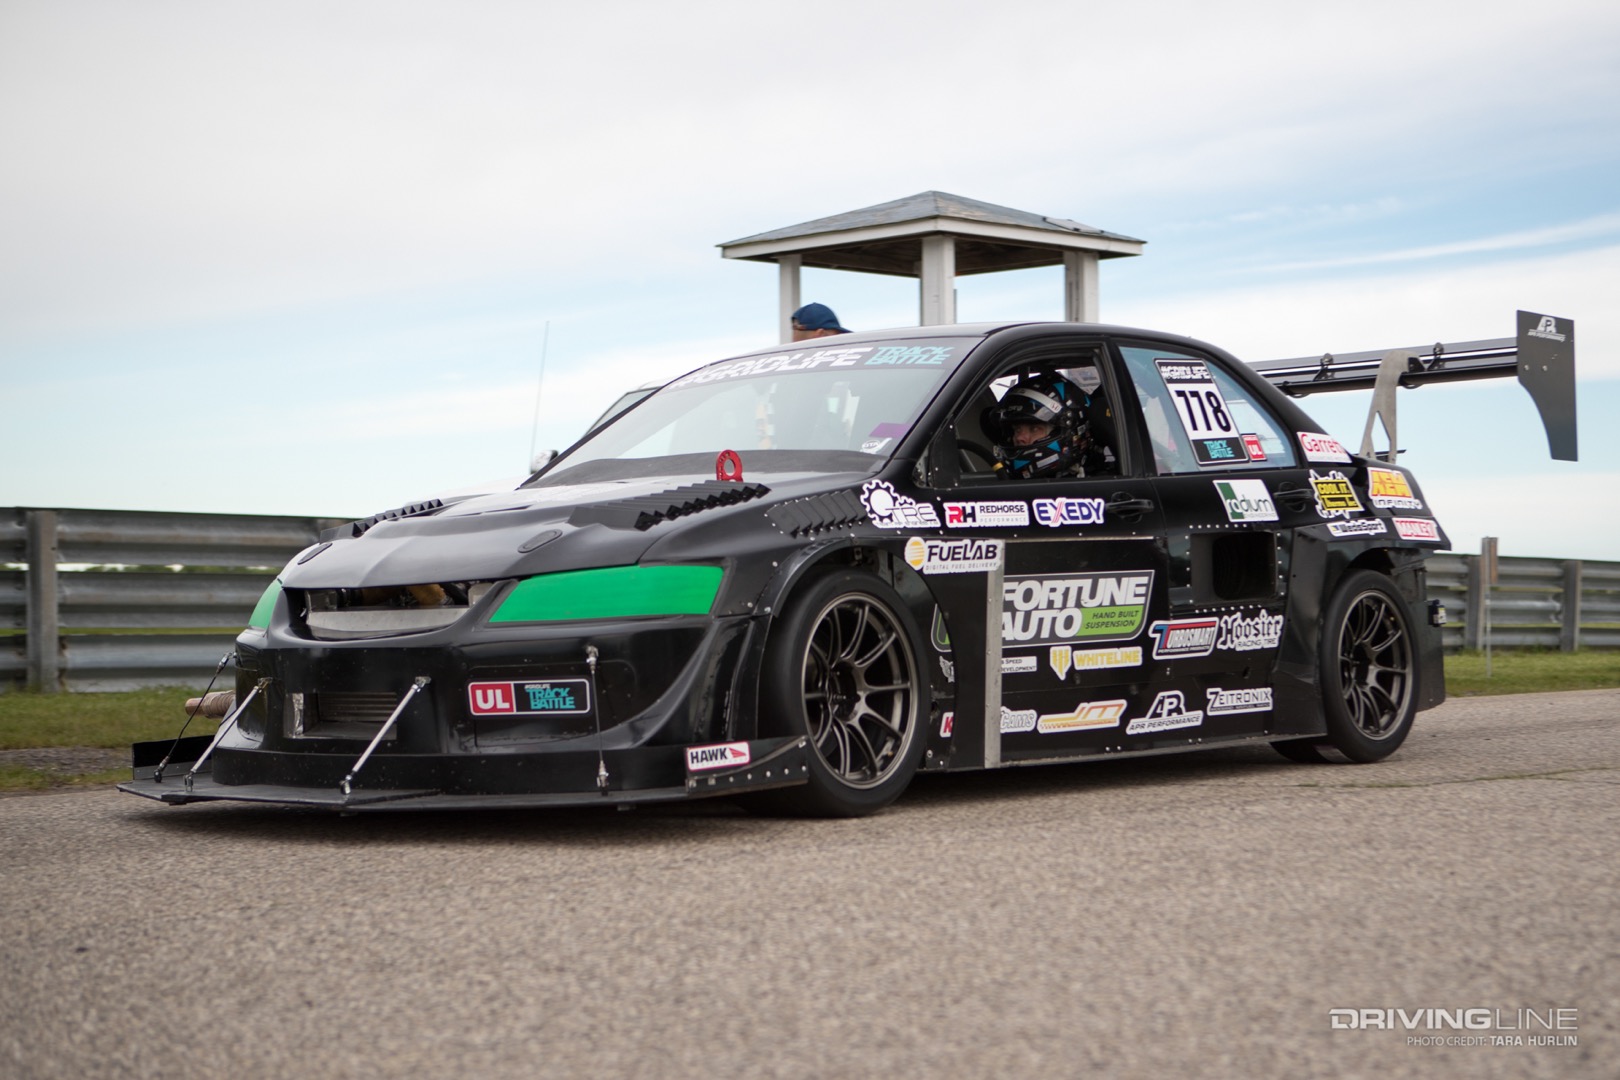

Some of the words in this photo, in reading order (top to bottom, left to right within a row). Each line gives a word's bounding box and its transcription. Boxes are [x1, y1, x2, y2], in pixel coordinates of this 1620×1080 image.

[878, 346, 955, 357] TRACK
[864, 354, 950, 365] BATTLE
[1174, 390, 1231, 432] 778
[1203, 440, 1229, 450] TRACK
[1248, 444, 1262, 455] UL
[1210, 447, 1235, 459] BATTLE
[1316, 483, 1341, 495] COOL
[980, 505, 1025, 514] REDHORSE
[1036, 501, 1101, 524] EXEDY
[980, 515, 1027, 523] PERFORMANCE
[968, 561, 997, 569] DELIVERY
[1092, 611, 1116, 620] HAND
[1117, 610, 1140, 618] BUILT
[1085, 620, 1135, 630] SUSPENSION
[1218, 611, 1281, 648] Hoosier
[1075, 650, 1140, 667] WHITELINE
[475, 689, 510, 710] UL
[525, 688, 570, 700] TRACK
[1209, 690, 1271, 709] ZEITRONIX
[530, 697, 576, 709] BATTLE
[1129, 723, 1146, 731] APR
[1147, 716, 1201, 729] PERFORMANCE
[690, 747, 728, 764] HAWK
